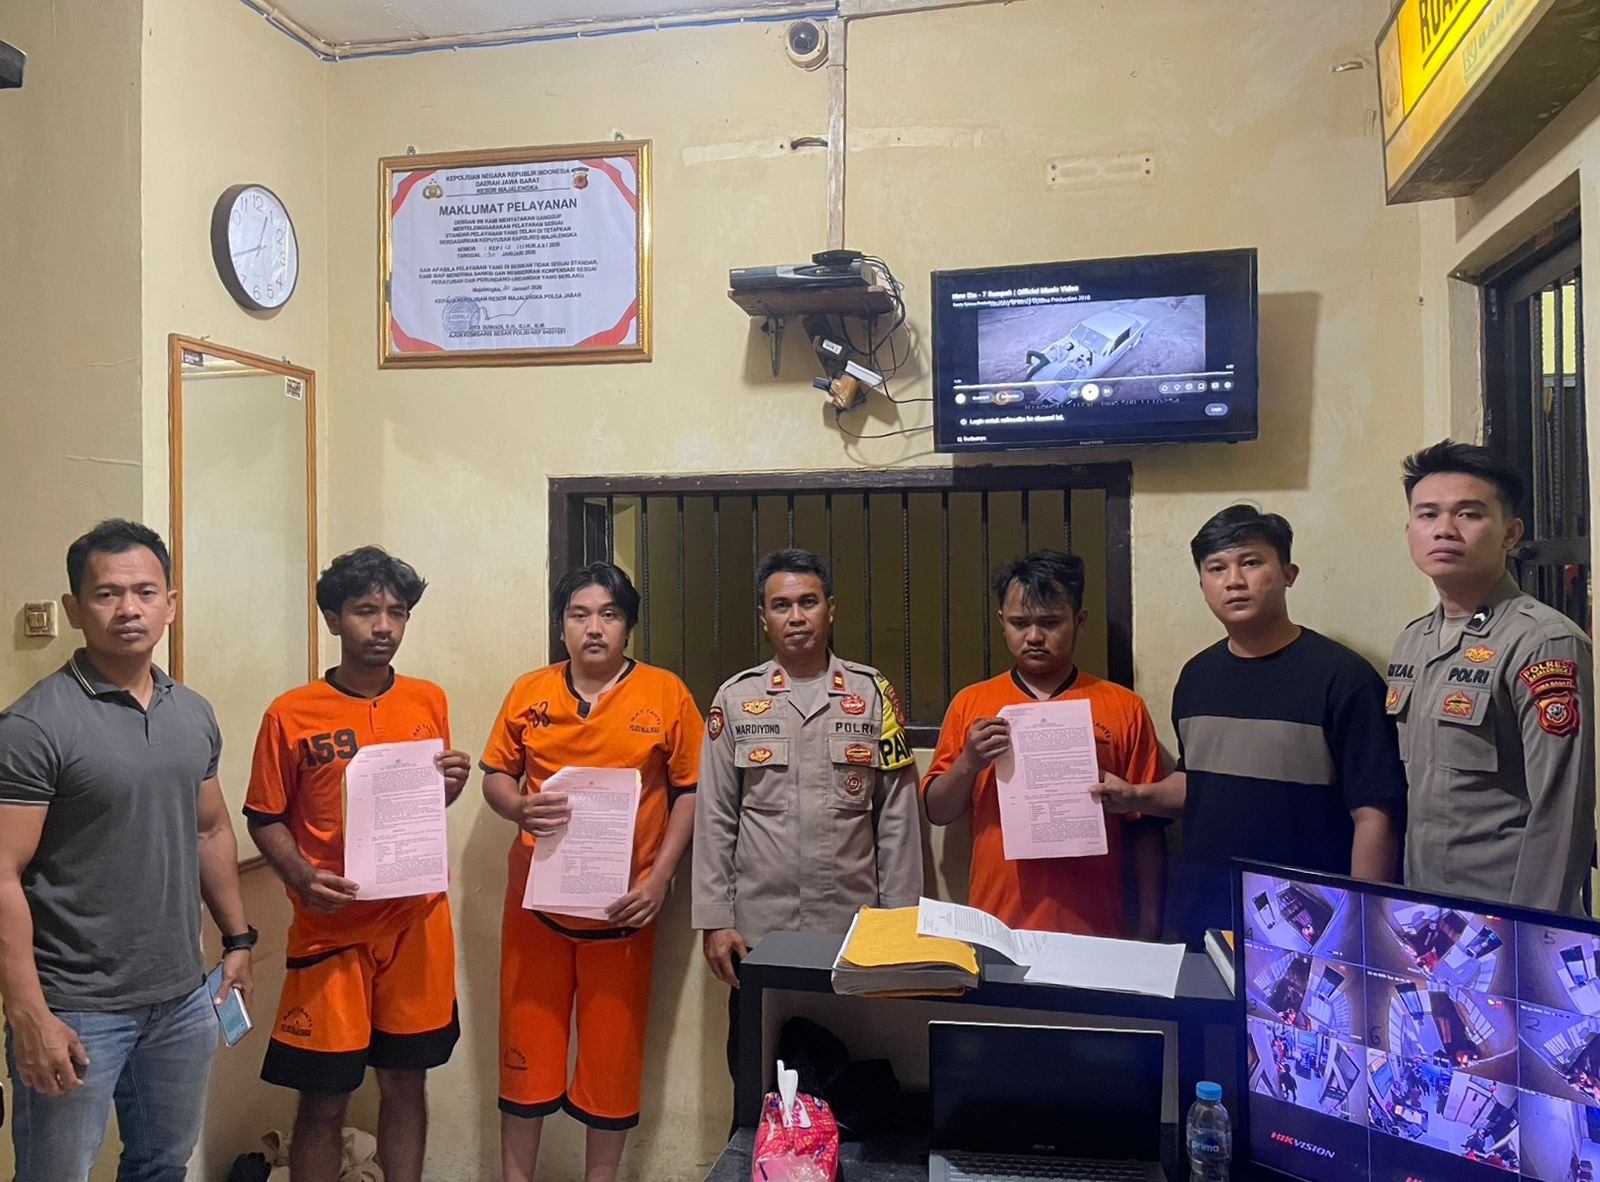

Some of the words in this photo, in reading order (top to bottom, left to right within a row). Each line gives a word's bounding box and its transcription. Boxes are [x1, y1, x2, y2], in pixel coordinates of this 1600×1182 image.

[1419, 0, 1458, 53] RUA
[446, 174, 480, 182] KEPOLISIAN
[481, 172, 506, 180] NEGARA
[507, 170, 538, 178] REPUBLIK
[240, 196, 248, 212] 11
[252, 194, 264, 212] 12
[438, 204, 504, 216] MAKLUMAT
[507, 198, 578, 212] PELAYANAN
[276, 228, 284, 246] 2
[253, 284, 261, 301] 6
[267, 284, 274, 299] 5
[1017, 287, 1040, 296] Official
[1040, 286, 1059, 294] Music
[1448, 667, 1490, 684] POLRI
[736, 724, 780, 736] MARDIYONO
[836, 722, 874, 734] POLRI
[299, 728, 358, 768] 159
[1526, 1017, 1542, 1032] 2
[1370, 1026, 1381, 1046] 6
[1192, 1140, 1220, 1152] Prima
[1270, 1130, 1336, 1158] HIKVISION
